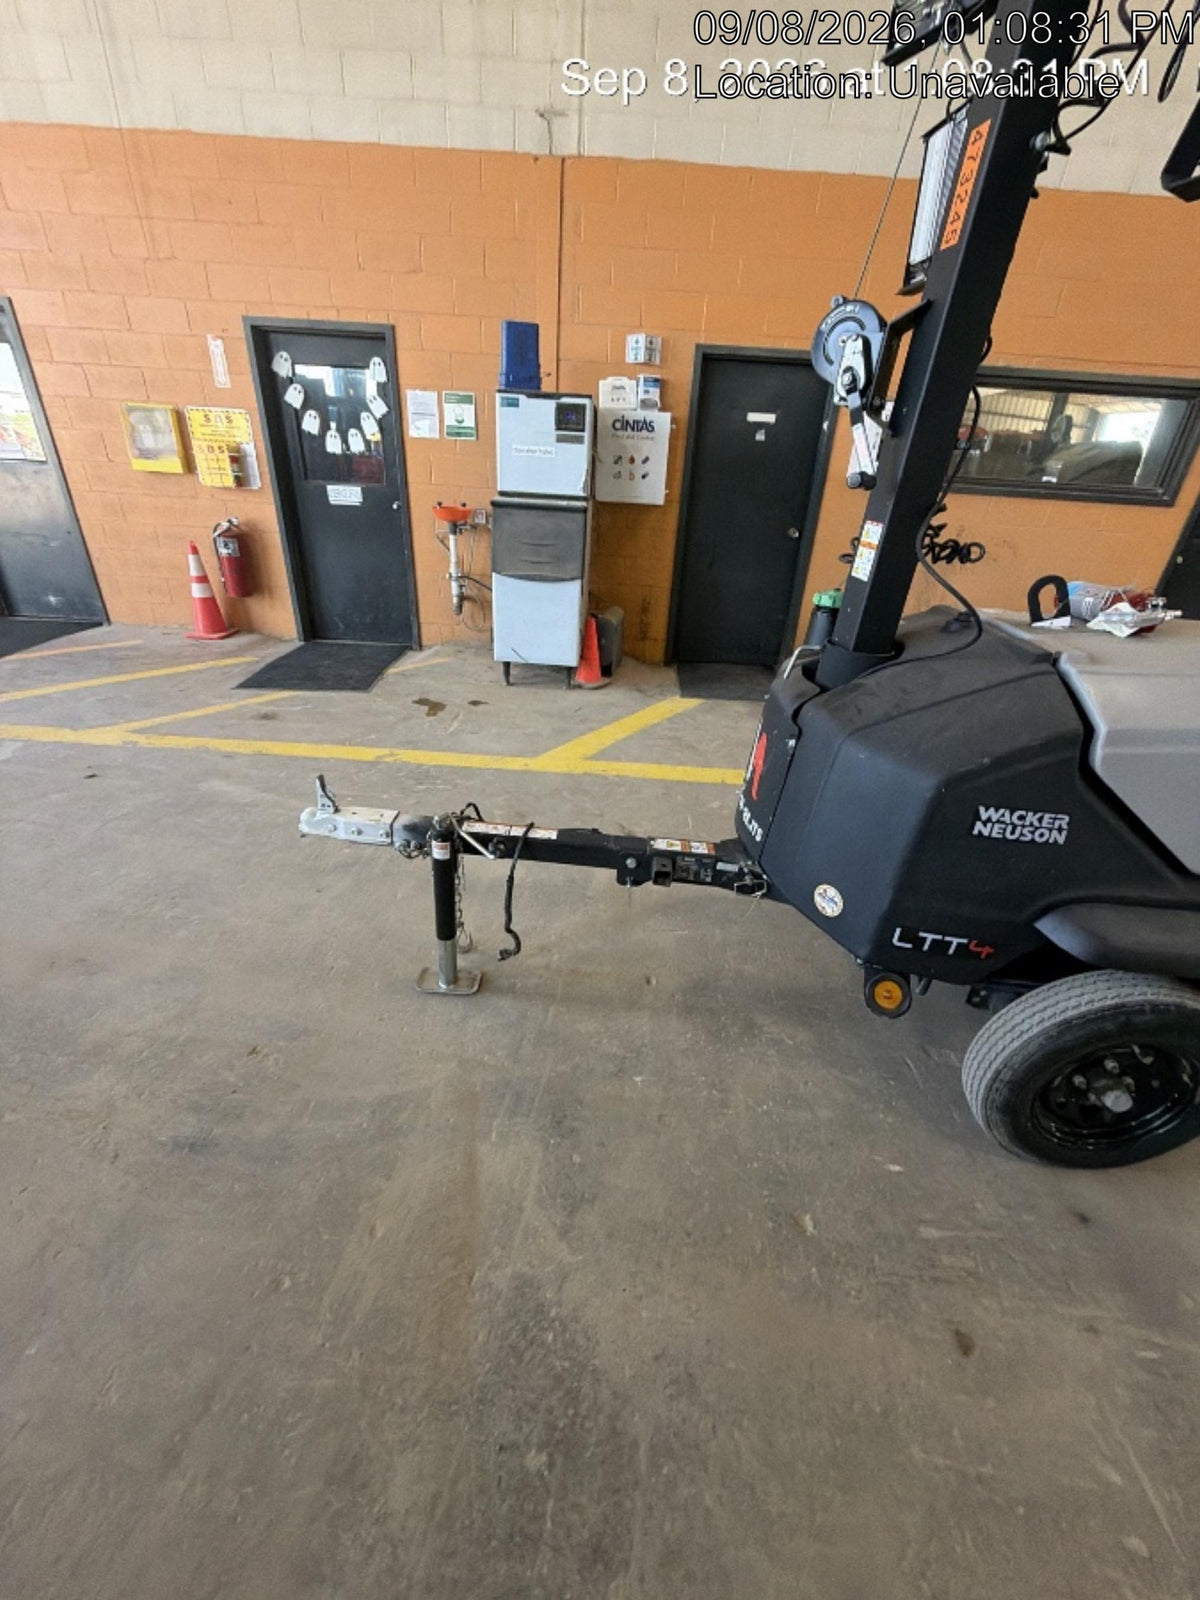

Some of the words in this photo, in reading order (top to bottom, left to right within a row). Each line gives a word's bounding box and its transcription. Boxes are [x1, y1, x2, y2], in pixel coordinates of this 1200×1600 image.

[978, 804, 1070, 829] WACKER
[971, 821, 1068, 845] NEUSON
[892, 927, 995, 959] LTT4
